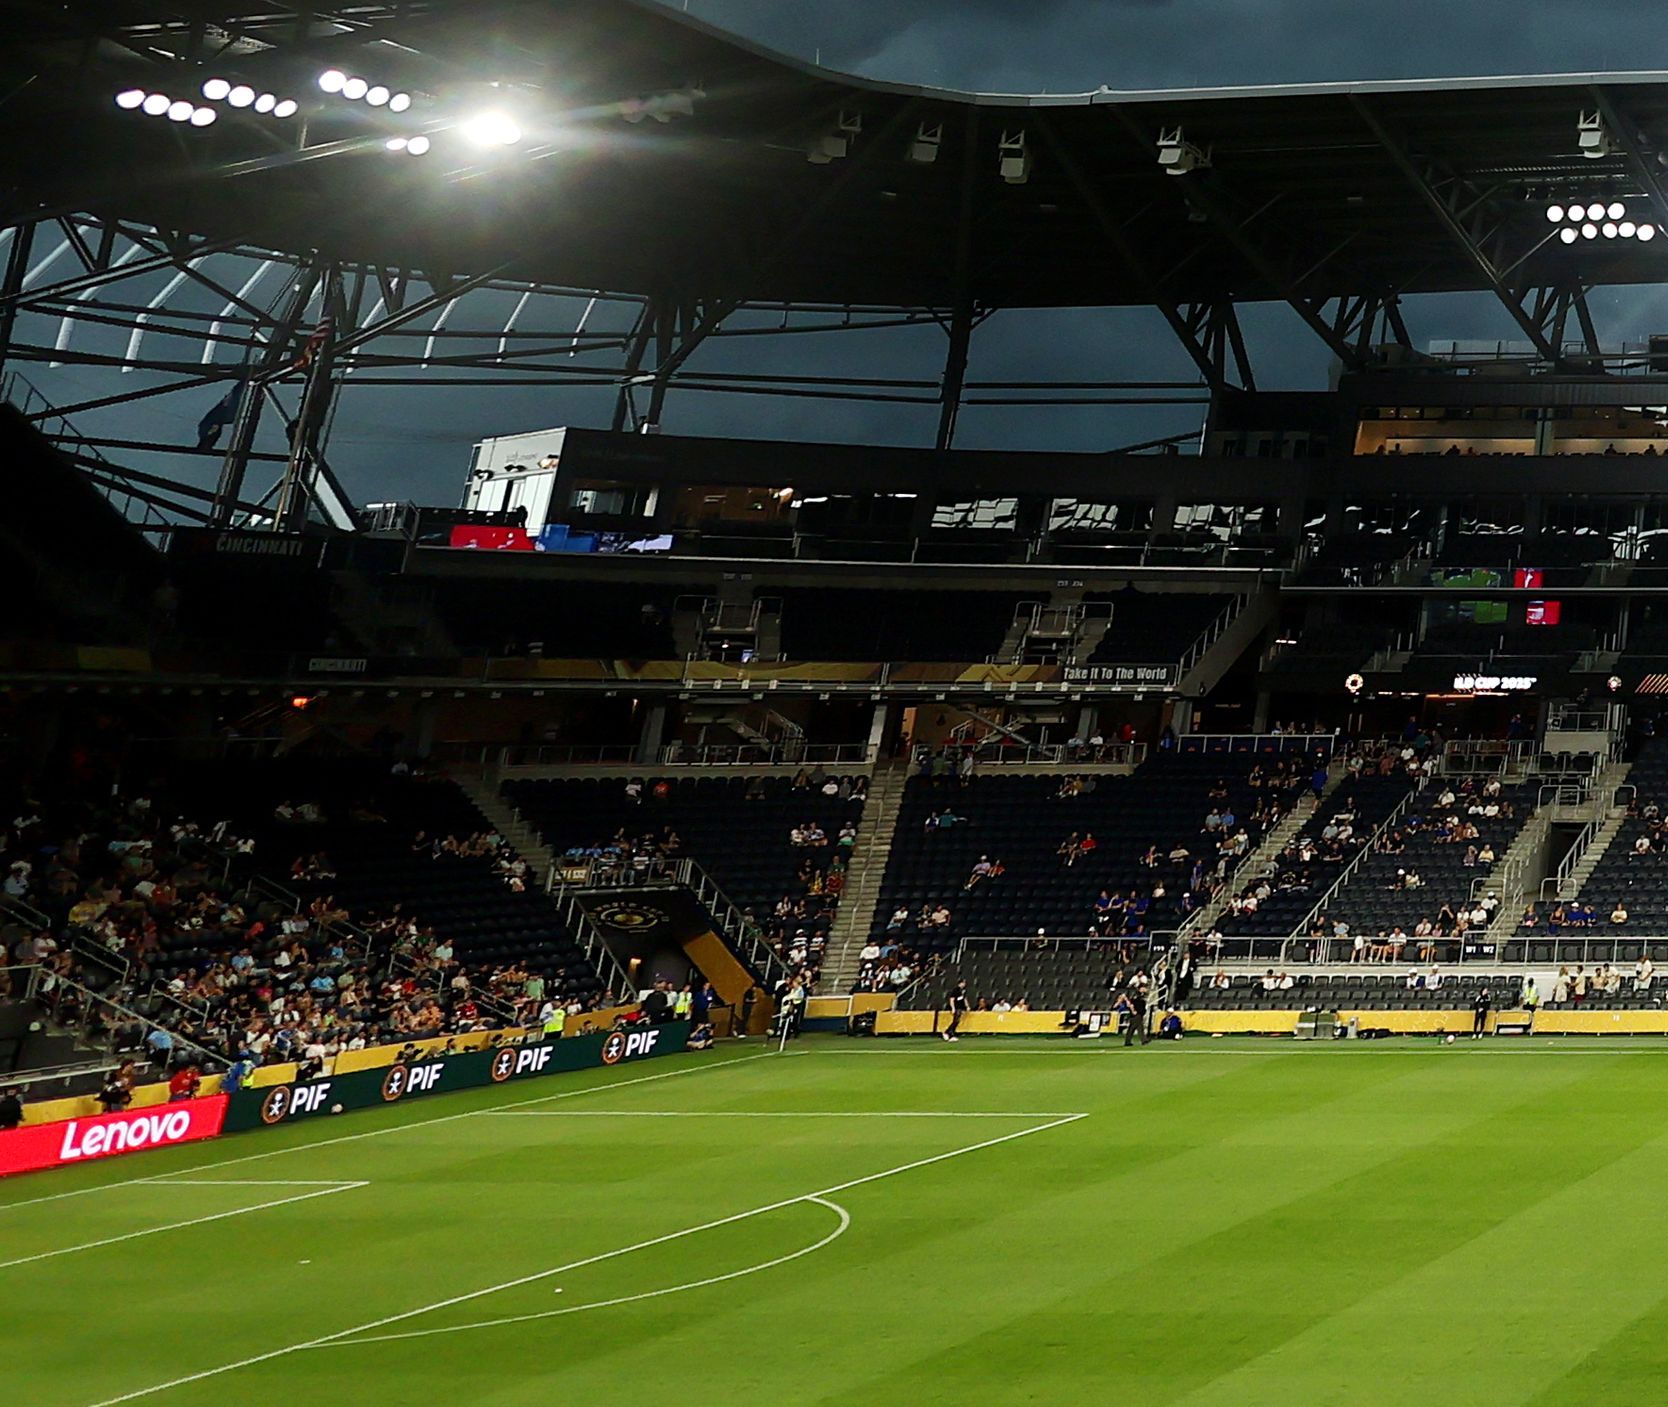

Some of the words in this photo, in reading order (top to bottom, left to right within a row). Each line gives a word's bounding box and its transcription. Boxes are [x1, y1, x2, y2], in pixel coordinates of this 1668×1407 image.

[216, 536, 304, 556] CINCINNATI
[1064, 667, 1089, 680] Take
[1101, 667, 1113, 680] To
[1115, 667, 1135, 680] The
[1136, 667, 1167, 680] World
[1475, 677, 1500, 689] CUP
[625, 1030, 660, 1057] PIF
[516, 1046, 554, 1074] PIF
[407, 1063, 444, 1093] PIF
[290, 1083, 330, 1114] PIF
[60, 1110, 190, 1160] Lenovo
